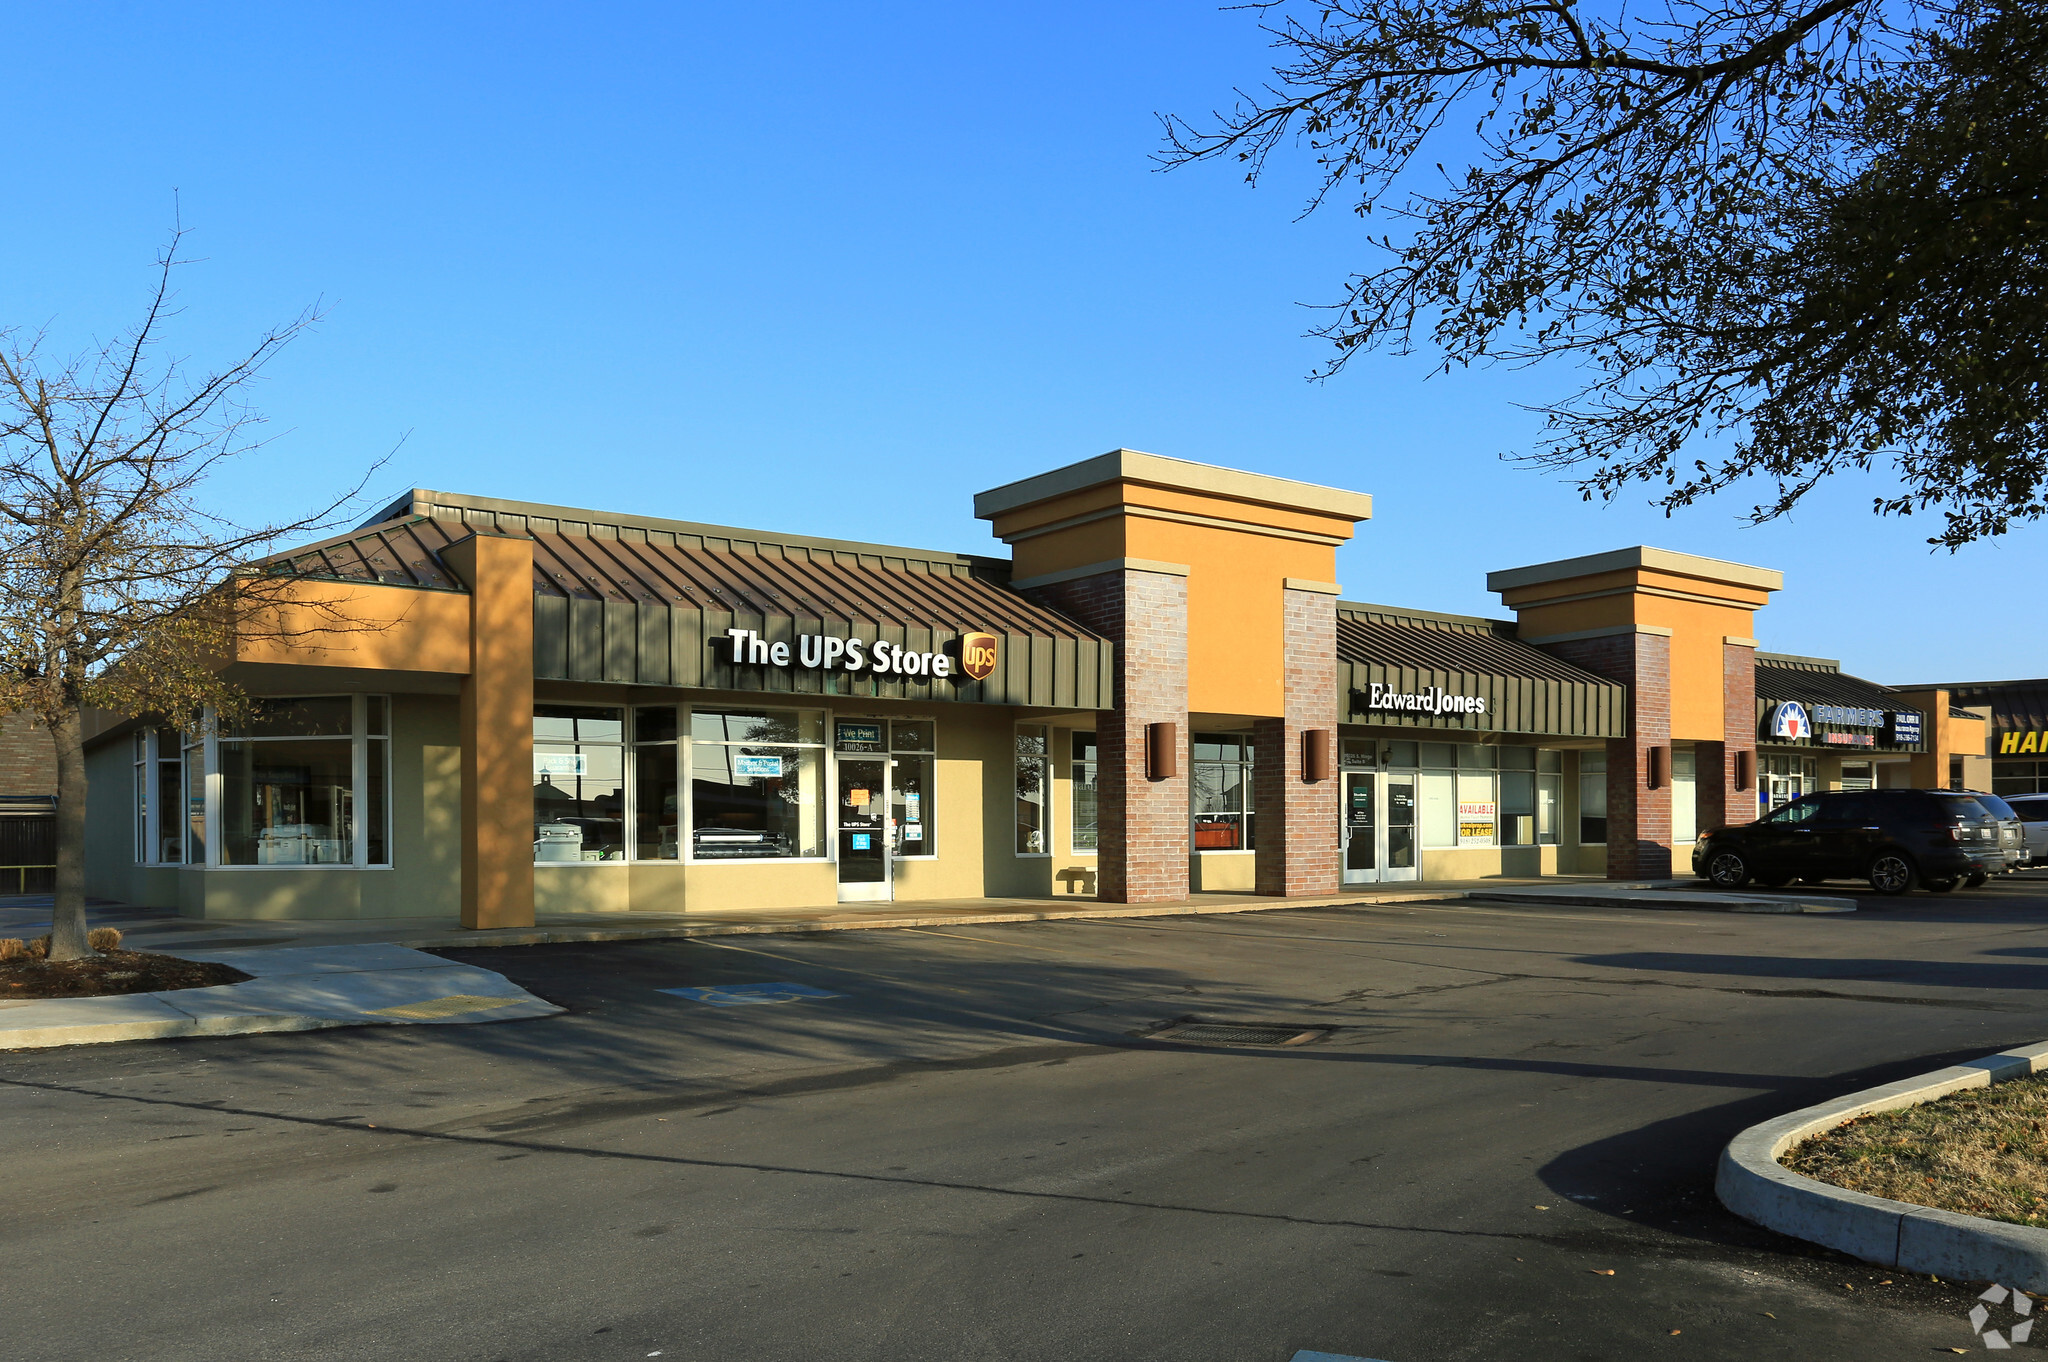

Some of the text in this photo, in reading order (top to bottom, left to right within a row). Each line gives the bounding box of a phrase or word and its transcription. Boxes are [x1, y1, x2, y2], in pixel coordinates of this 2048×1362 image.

[728, 628, 950, 676] The UPS Store
[965, 646, 994, 673] ups
[1815, 705, 1885, 728] FARMERS
[844, 728, 874, 738] We Print
[1827, 733, 1874, 746] INSURANCE
[1460, 805, 1494, 814] AVAILABLE
